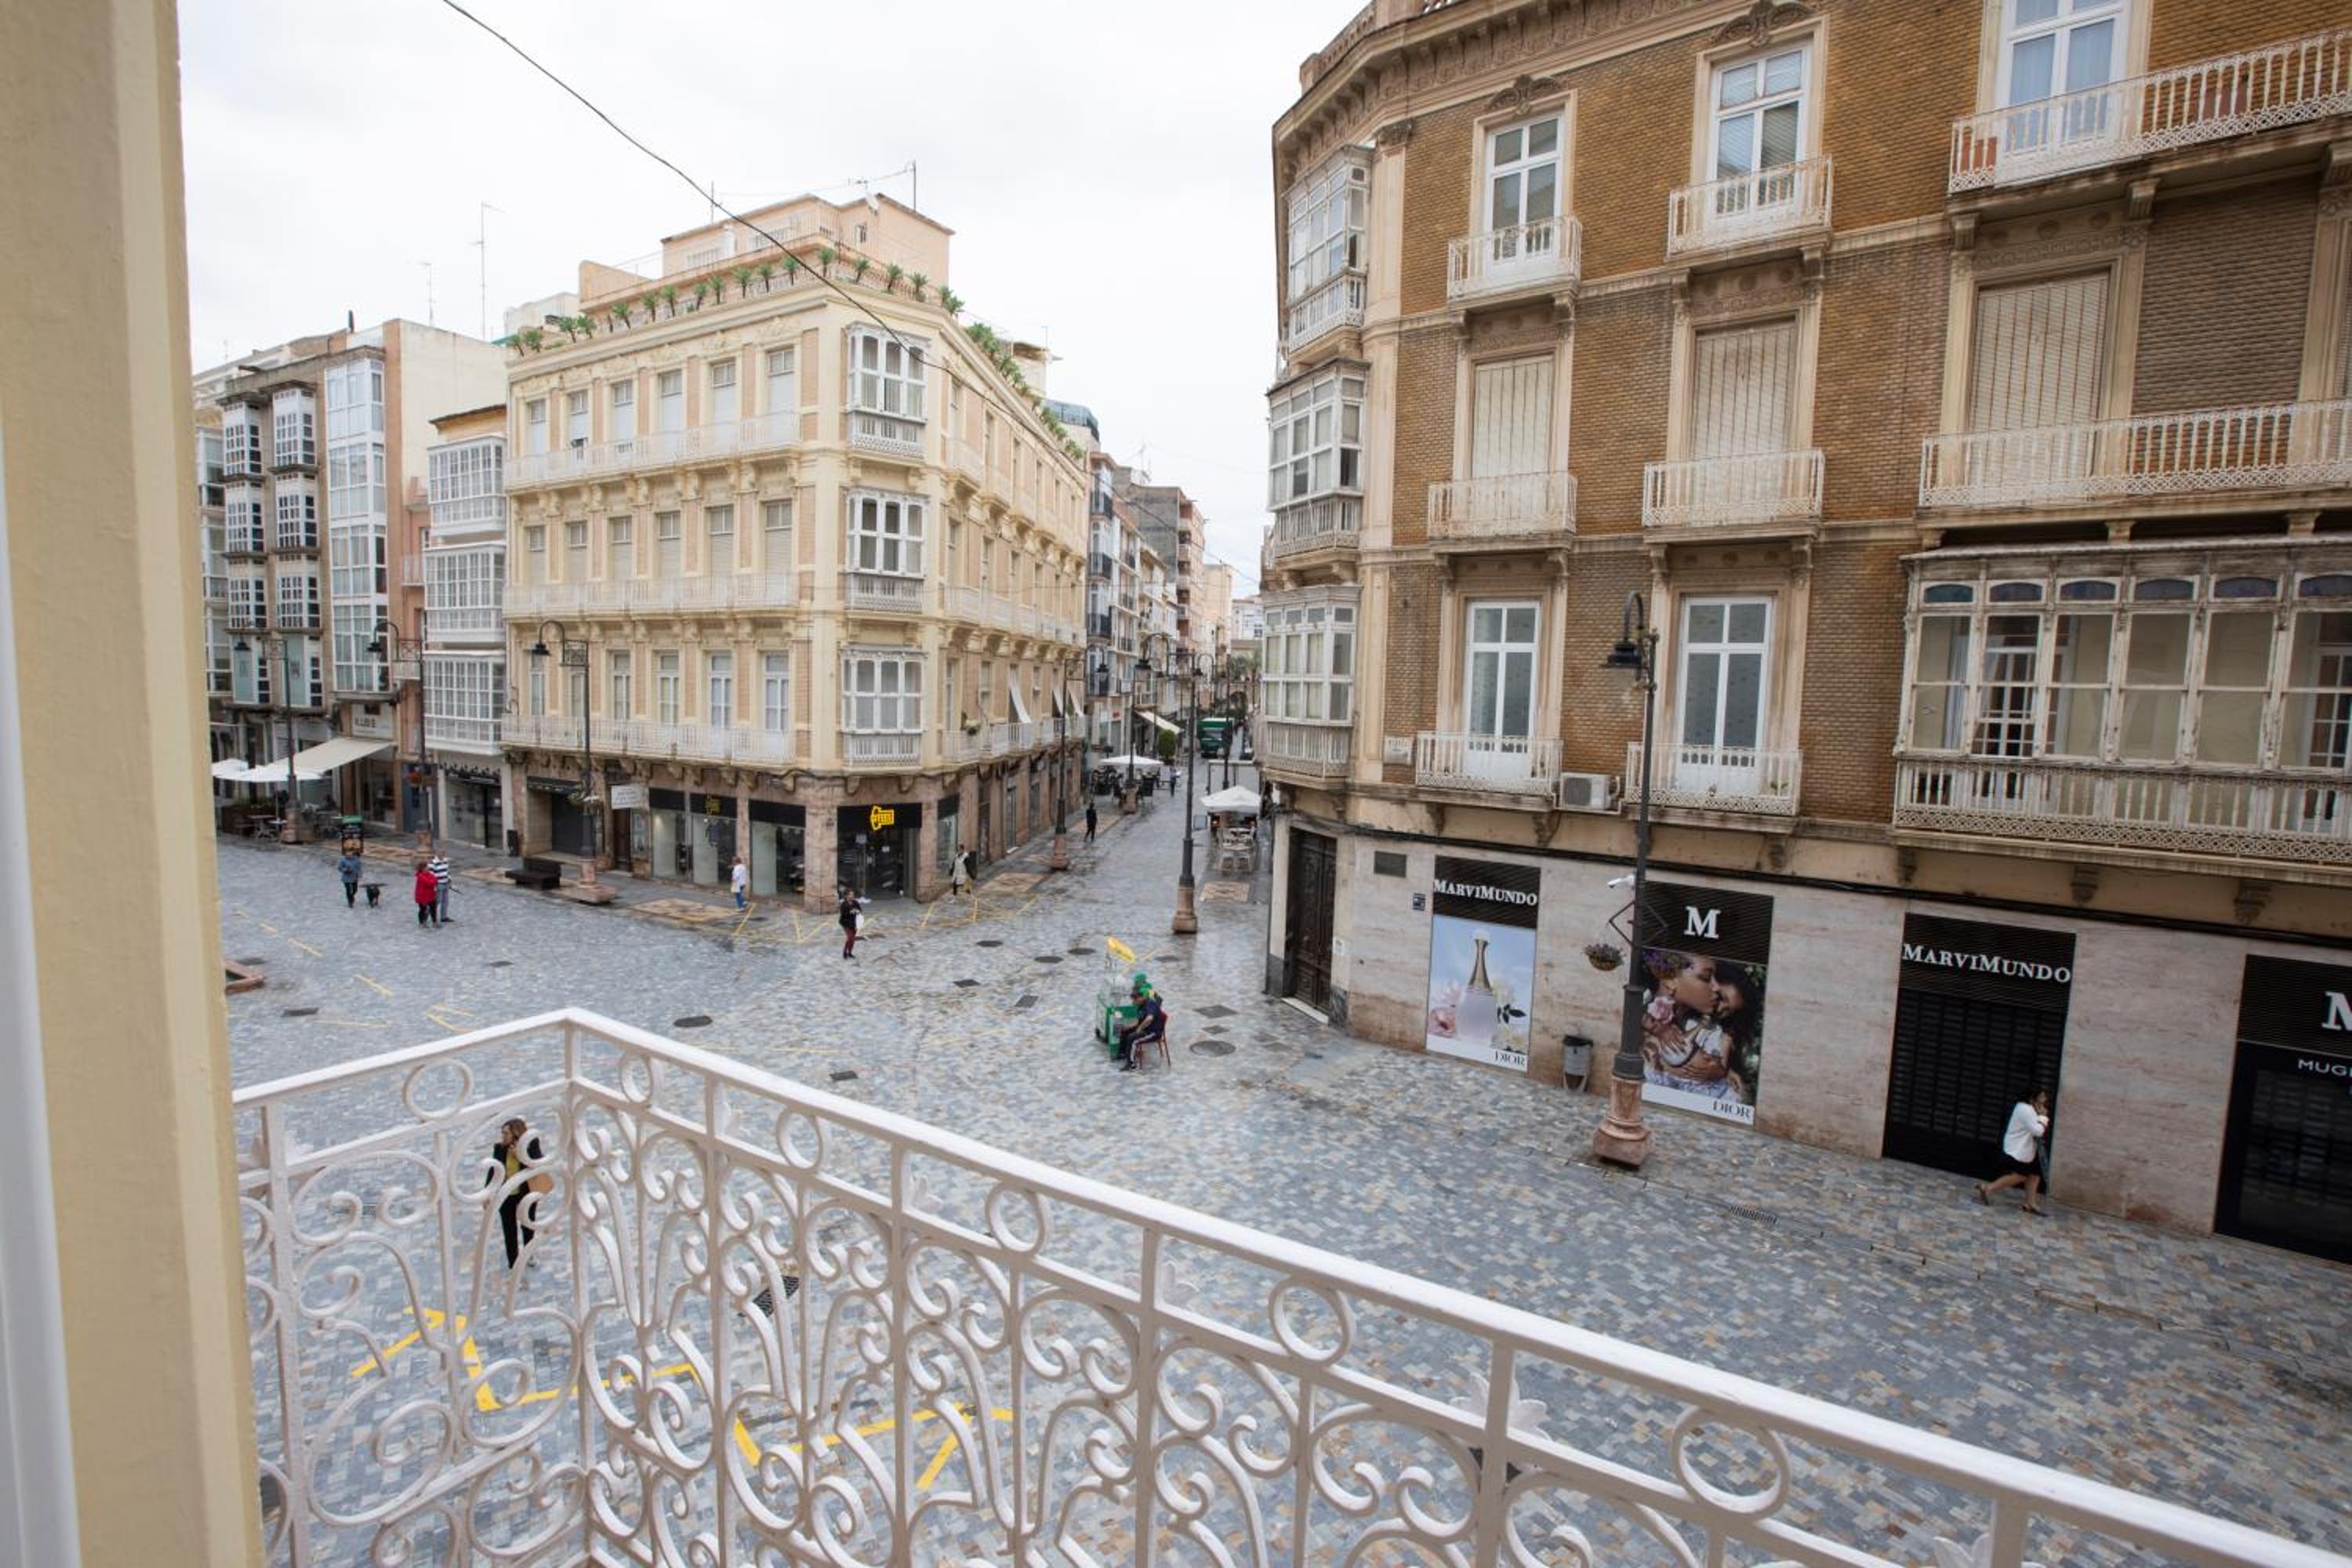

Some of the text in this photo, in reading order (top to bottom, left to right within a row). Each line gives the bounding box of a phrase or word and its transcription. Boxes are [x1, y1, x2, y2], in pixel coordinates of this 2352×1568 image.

[1432, 879, 1537, 906] MARVIMUNDO
[1683, 906, 1722, 939] M
[1901, 943, 2071, 983] MARVIMUNDO
[1494, 1050, 1526, 1067] DIOR
[2297, 1058, 2352, 1078] MUG
[1712, 1100, 1751, 1119] DIOR
